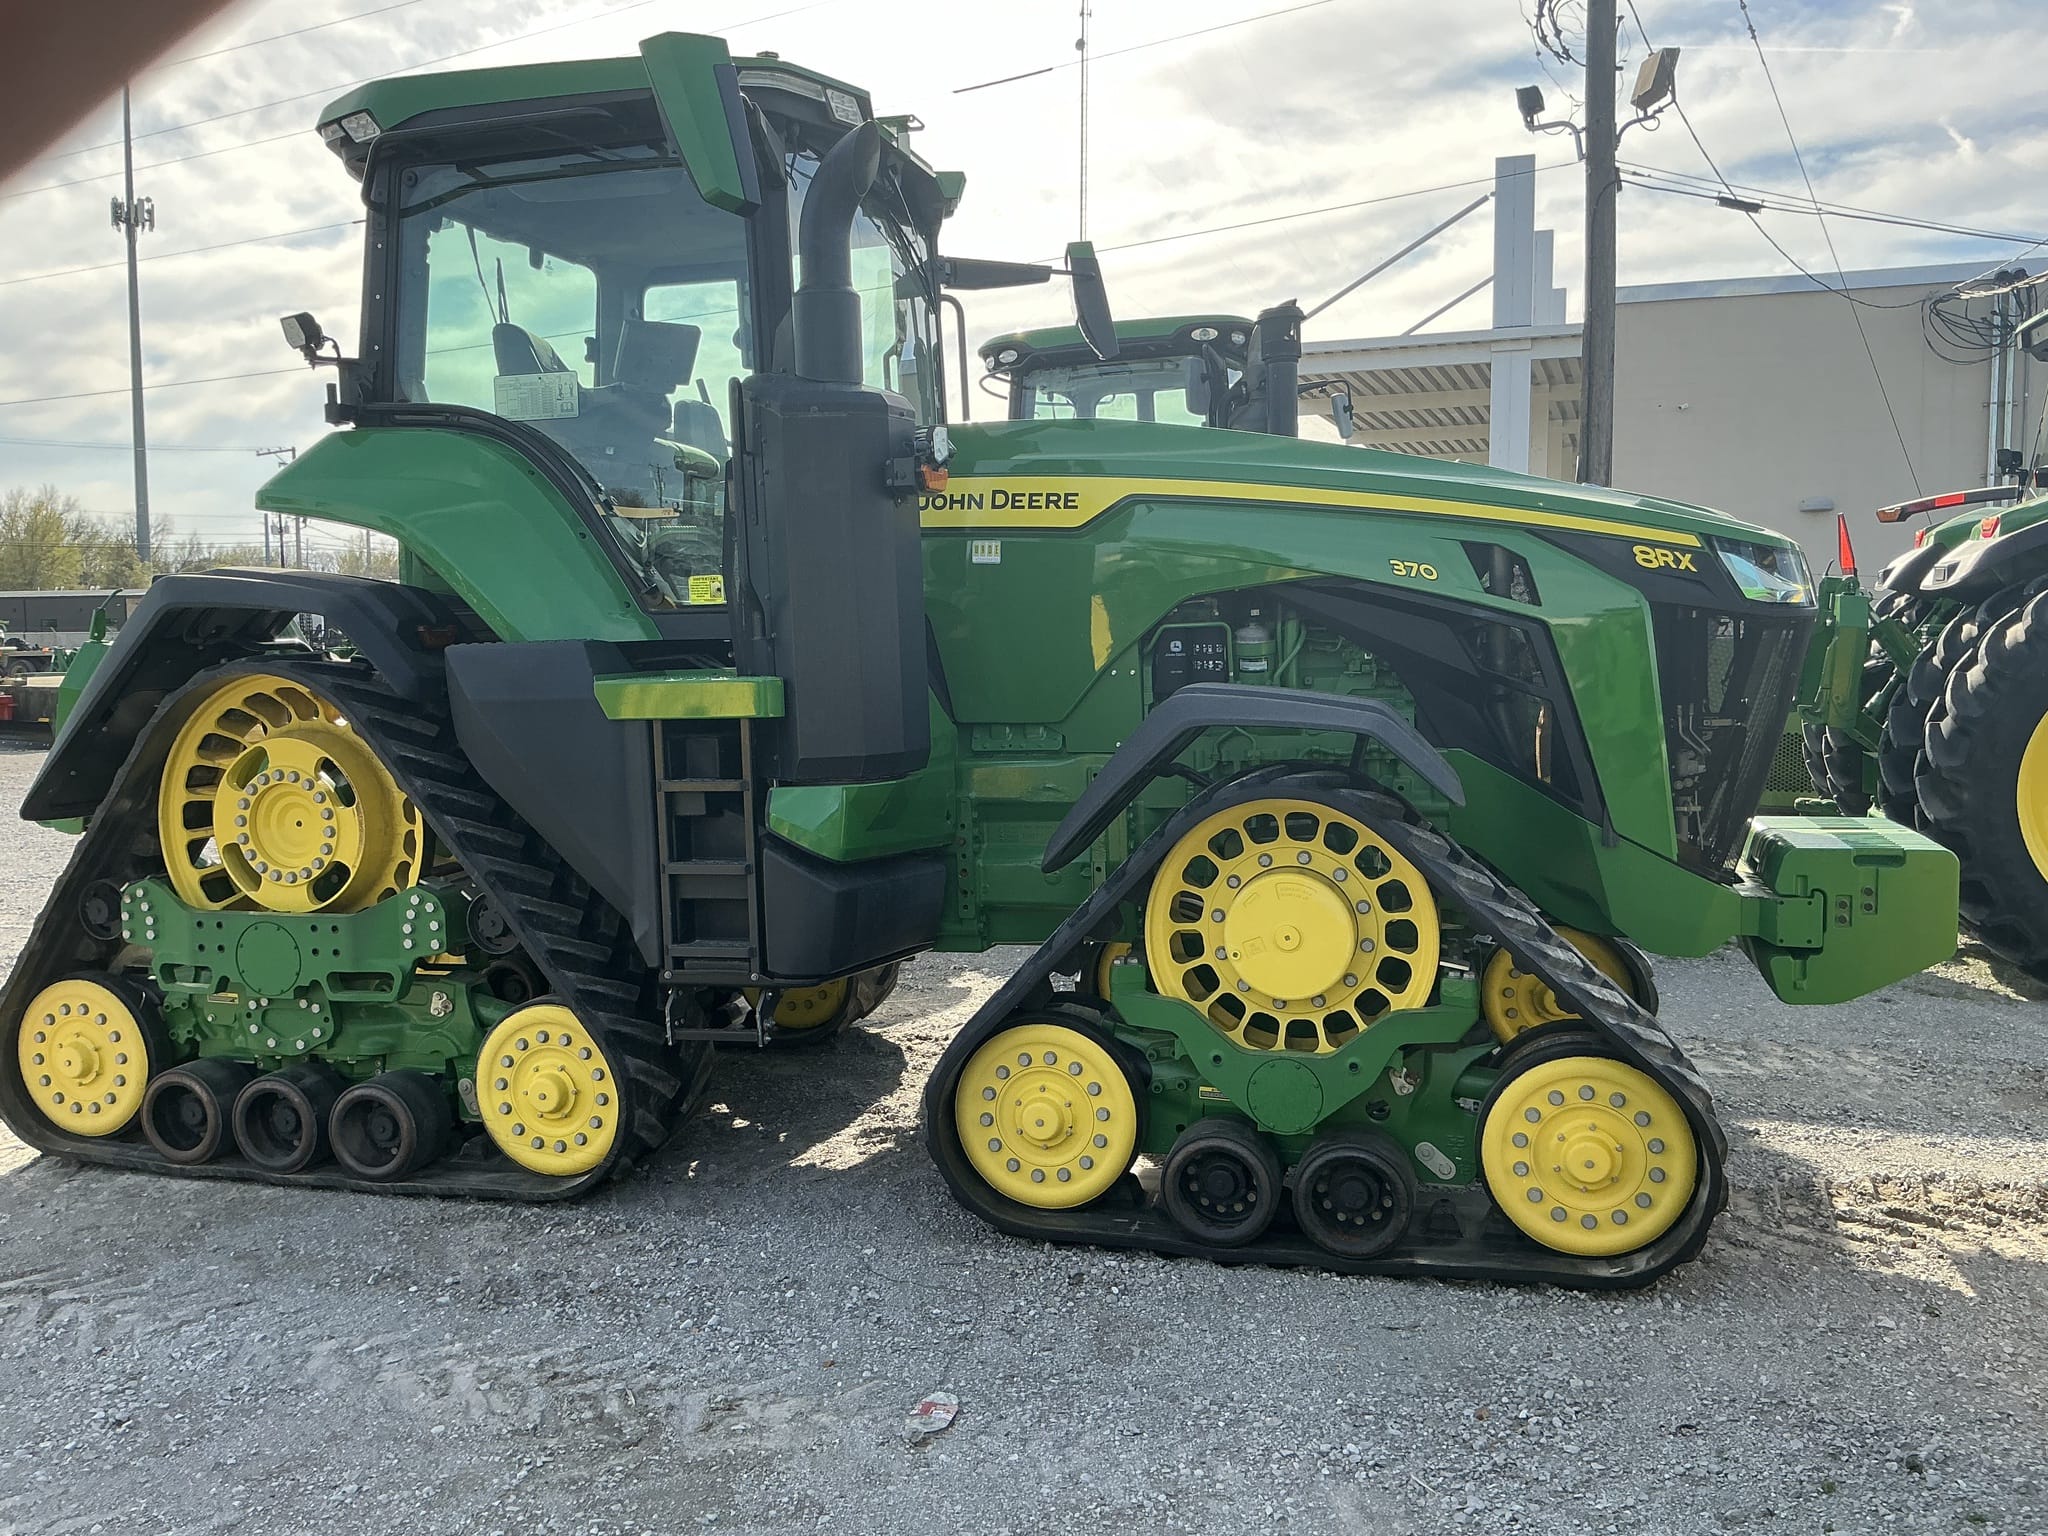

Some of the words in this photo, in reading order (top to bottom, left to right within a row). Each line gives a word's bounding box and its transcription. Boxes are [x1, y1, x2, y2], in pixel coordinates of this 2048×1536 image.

[991, 489, 1079, 510] DEERE
[1389, 559, 1438, 580] 370
[1632, 545, 1698, 573] 8RX
